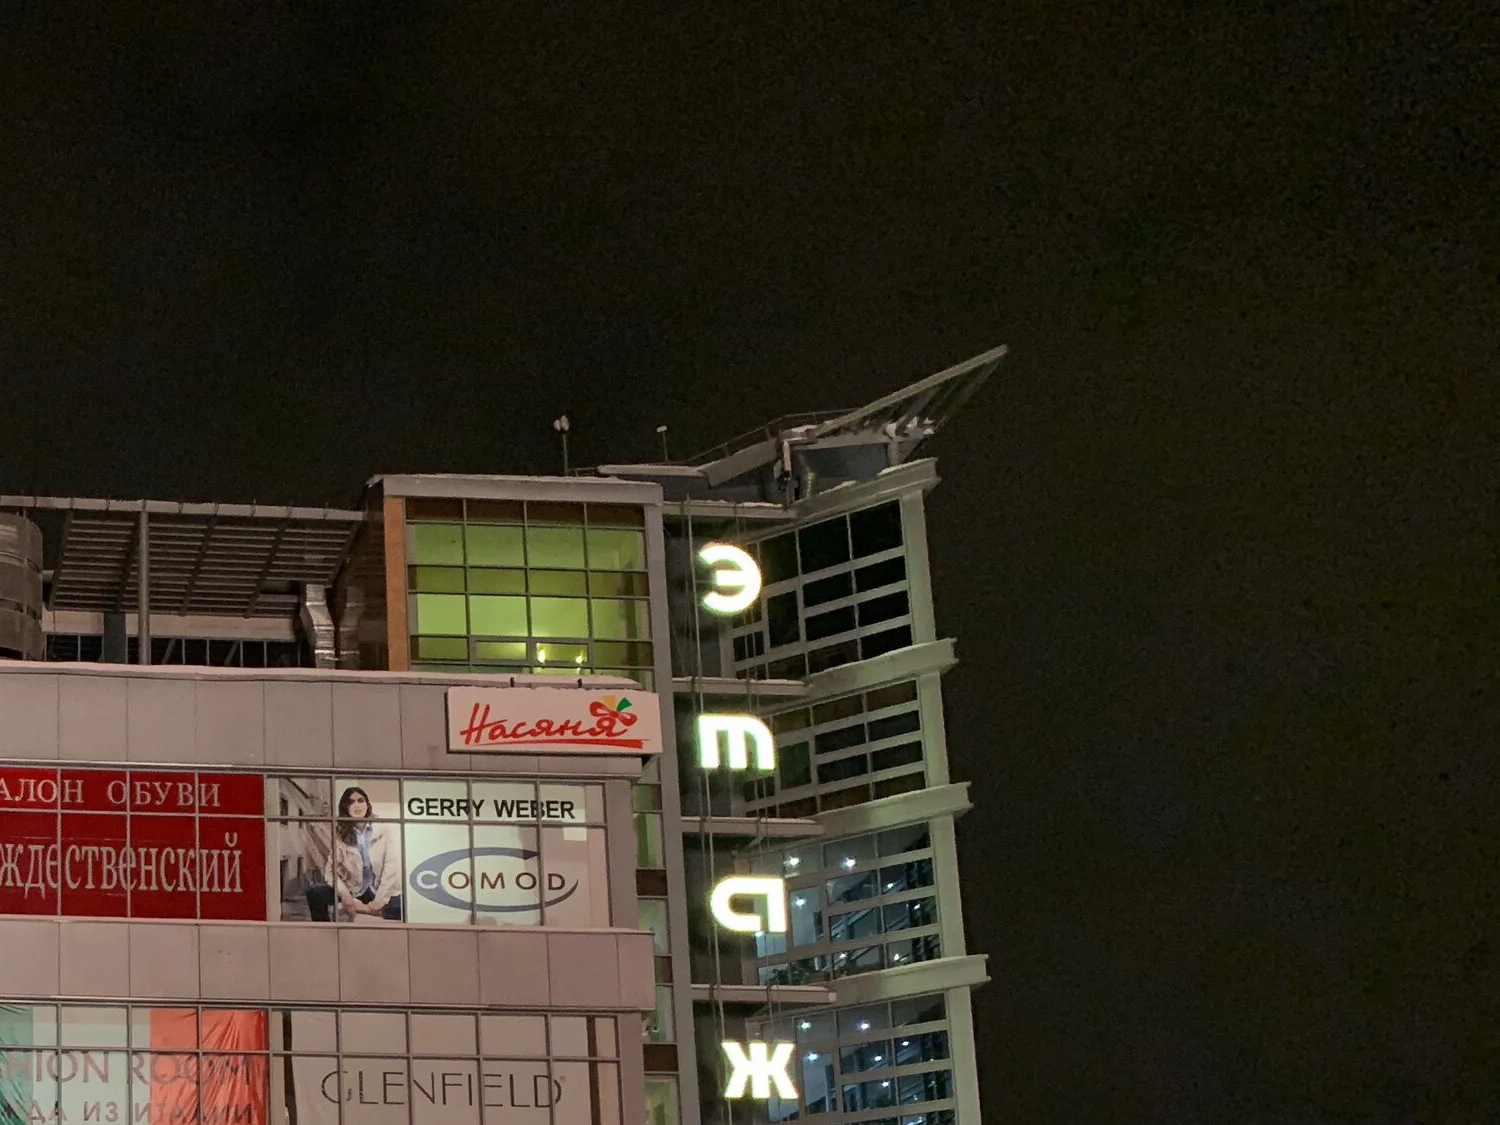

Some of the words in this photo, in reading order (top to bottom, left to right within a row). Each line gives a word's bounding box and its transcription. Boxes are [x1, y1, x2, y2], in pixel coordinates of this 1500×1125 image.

[460, 702, 628, 745] Насяня
[107, 781, 220, 807] ОБУВИ
[408, 797, 482, 818] GERRY
[494, 798, 575, 819] WEBER
[415, 870, 566, 891] COMOD
[321, 1070, 562, 1108] GLENFIELD
